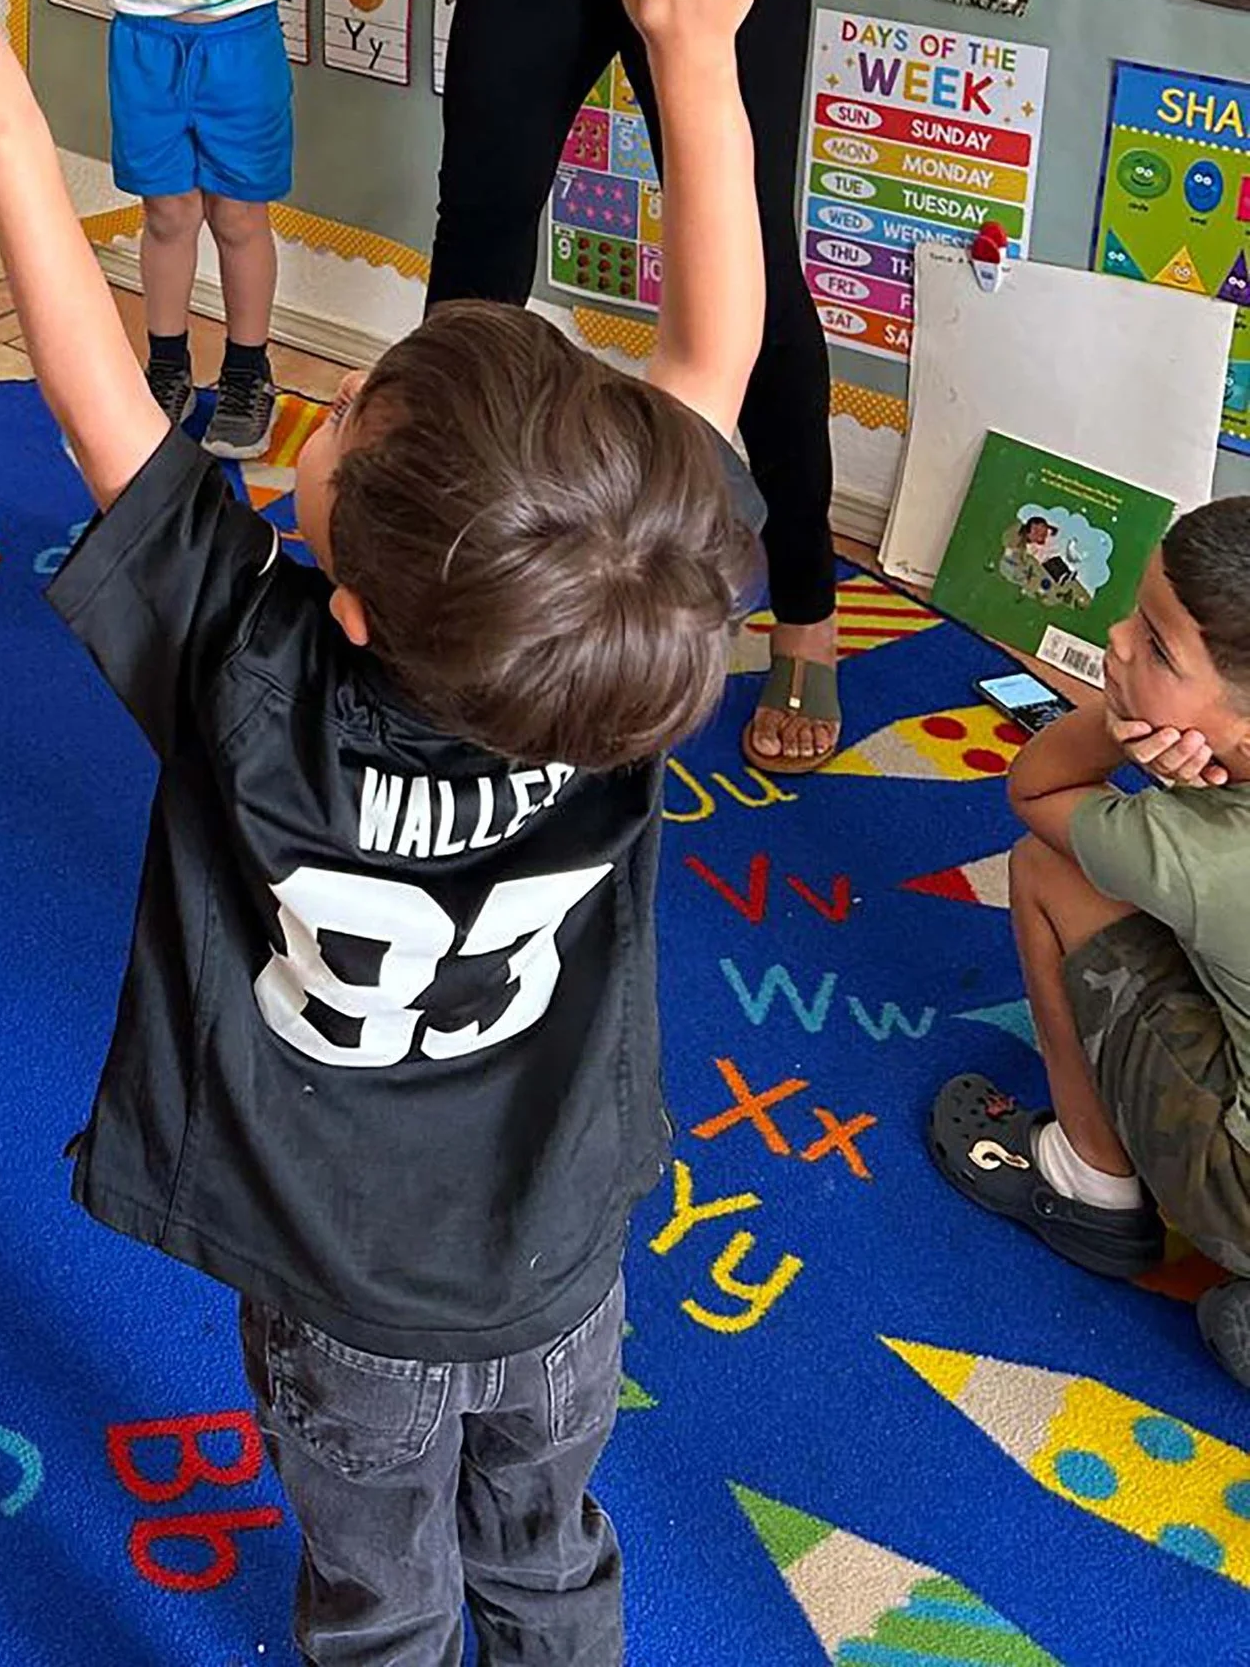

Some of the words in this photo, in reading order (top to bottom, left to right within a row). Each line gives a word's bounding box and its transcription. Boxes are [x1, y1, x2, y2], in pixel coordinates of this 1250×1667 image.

[343, 17, 384, 70] Yy
[840, 19, 909, 53] DAYS
[919, 33, 957, 60] OF
[968, 42, 1018, 73] THE
[858, 51, 995, 116] WEEK
[837, 106, 871, 127] SUN
[910, 118, 993, 153] SUNDAY
[1156, 87, 1250, 141] SHA
[831, 140, 873, 161] MON
[901, 153, 995, 190] MONDAY
[834, 174, 864, 195] TUE
[902, 189, 990, 225] TUESDAY
[557, 238, 572, 261] 9
[829, 209, 864, 230] WED
[882, 219, 972, 249] WEDNES
[829, 244, 861, 264] THU
[827, 276, 856, 296] FRI
[825, 310, 853, 326] SAT
[683, 852, 851, 924] Vv
[253, 862, 615, 1069] 83
[718, 956, 937, 1041] Ww
[689, 1056, 878, 1180] Xx
[649, 1158, 805, 1335] Yy
[104, 1408, 284, 1594] Bb
